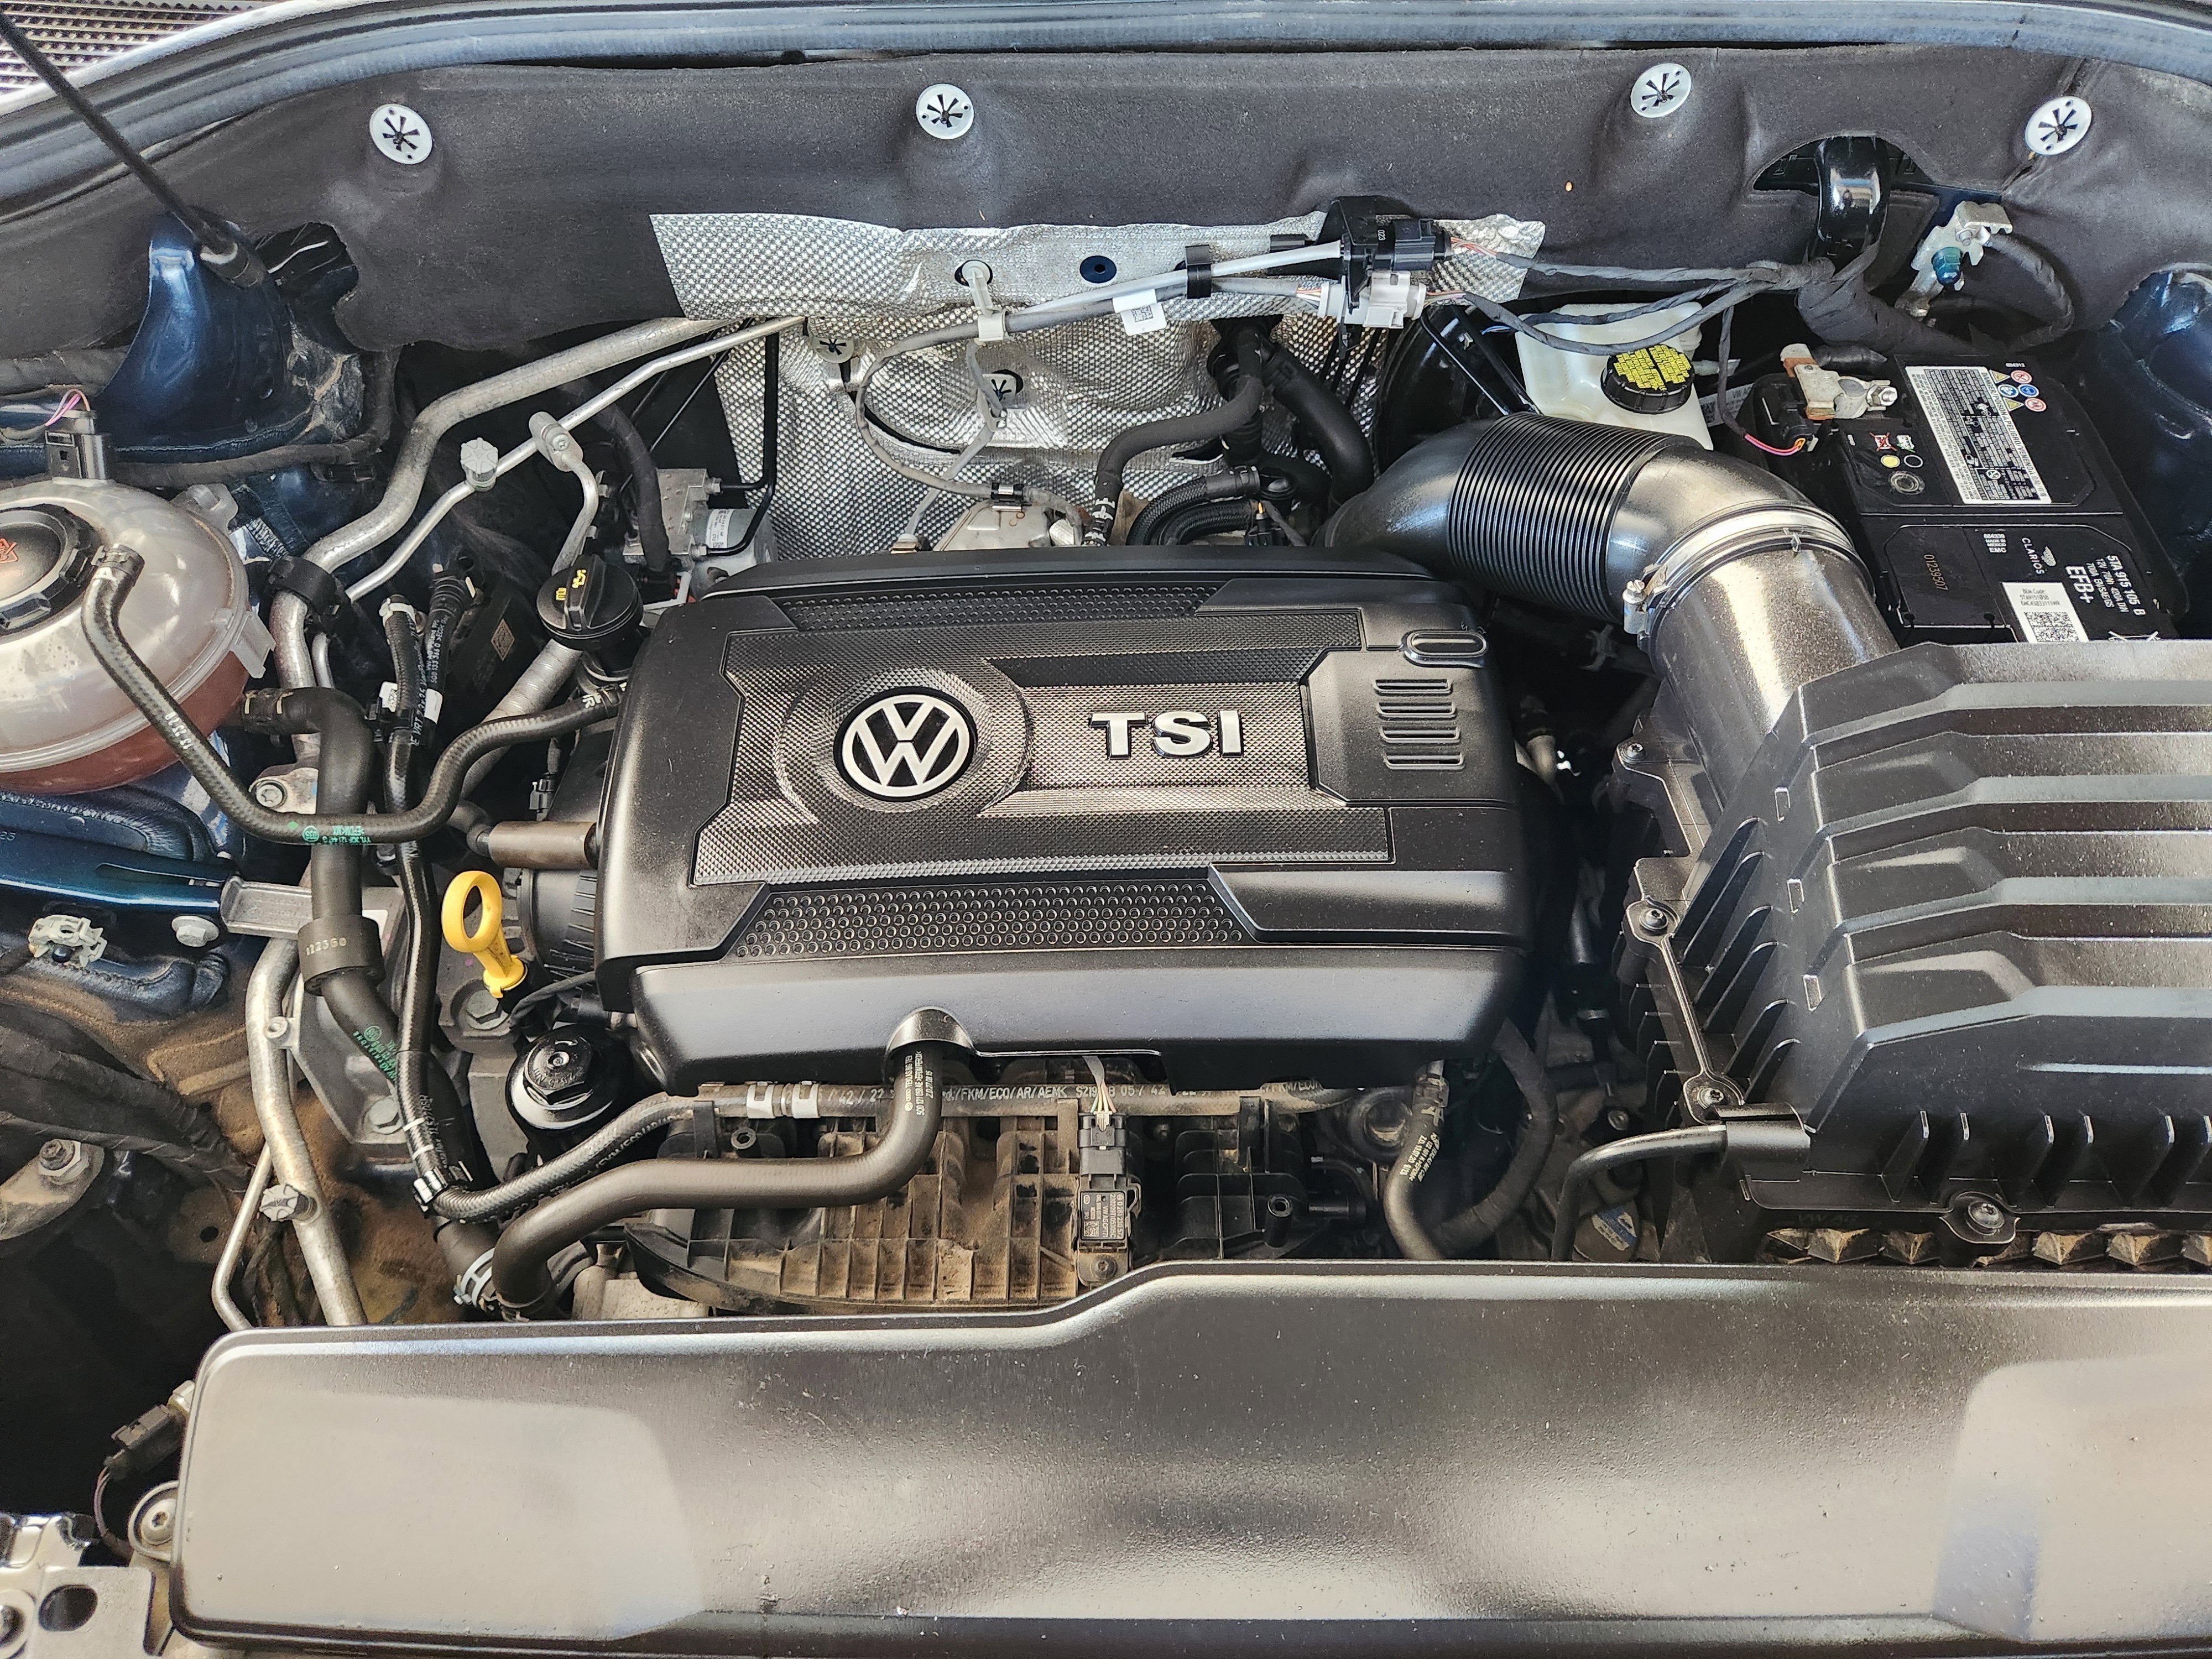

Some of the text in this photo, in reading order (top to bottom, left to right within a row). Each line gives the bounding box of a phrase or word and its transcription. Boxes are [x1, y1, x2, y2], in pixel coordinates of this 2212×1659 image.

[1923, 554, 1949, 591] 01239507
[2021, 538, 2045, 575] CLARIOS
[2065, 566, 2095, 604] EFB+
[2106, 555, 2123, 571] 5TA
[2115, 571, 2132, 587] 915
[2124, 588, 2141, 605] 105
[1090, 710, 1244, 760] TSI
